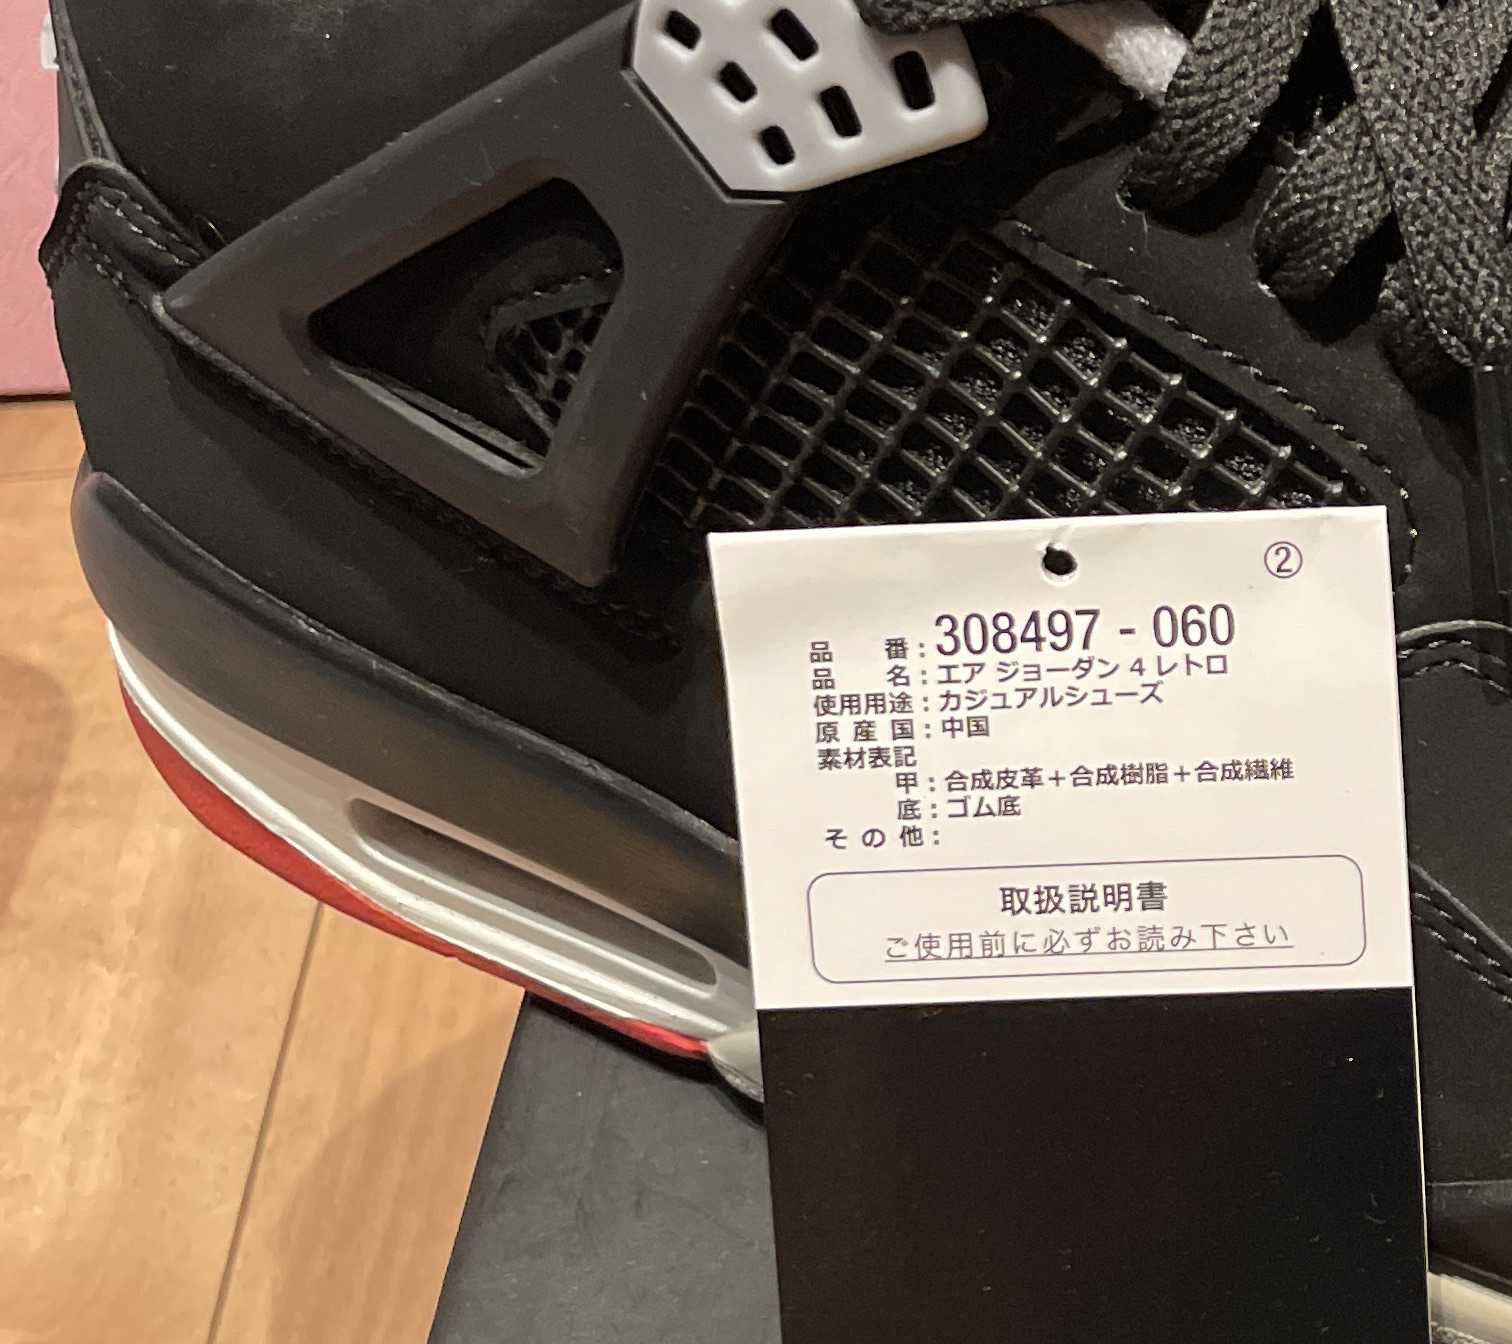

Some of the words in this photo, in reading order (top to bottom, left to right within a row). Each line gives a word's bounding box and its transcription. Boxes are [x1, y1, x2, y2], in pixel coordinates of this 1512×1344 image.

[934, 608, 1101, 657] 308497
[1152, 603, 1236, 648] 060
[817, 744, 918, 771] 素材表記
[999, 880, 1170, 917] 取扱説明書
[885, 921, 1290, 961] ご使用前に必ずお読み下さい
